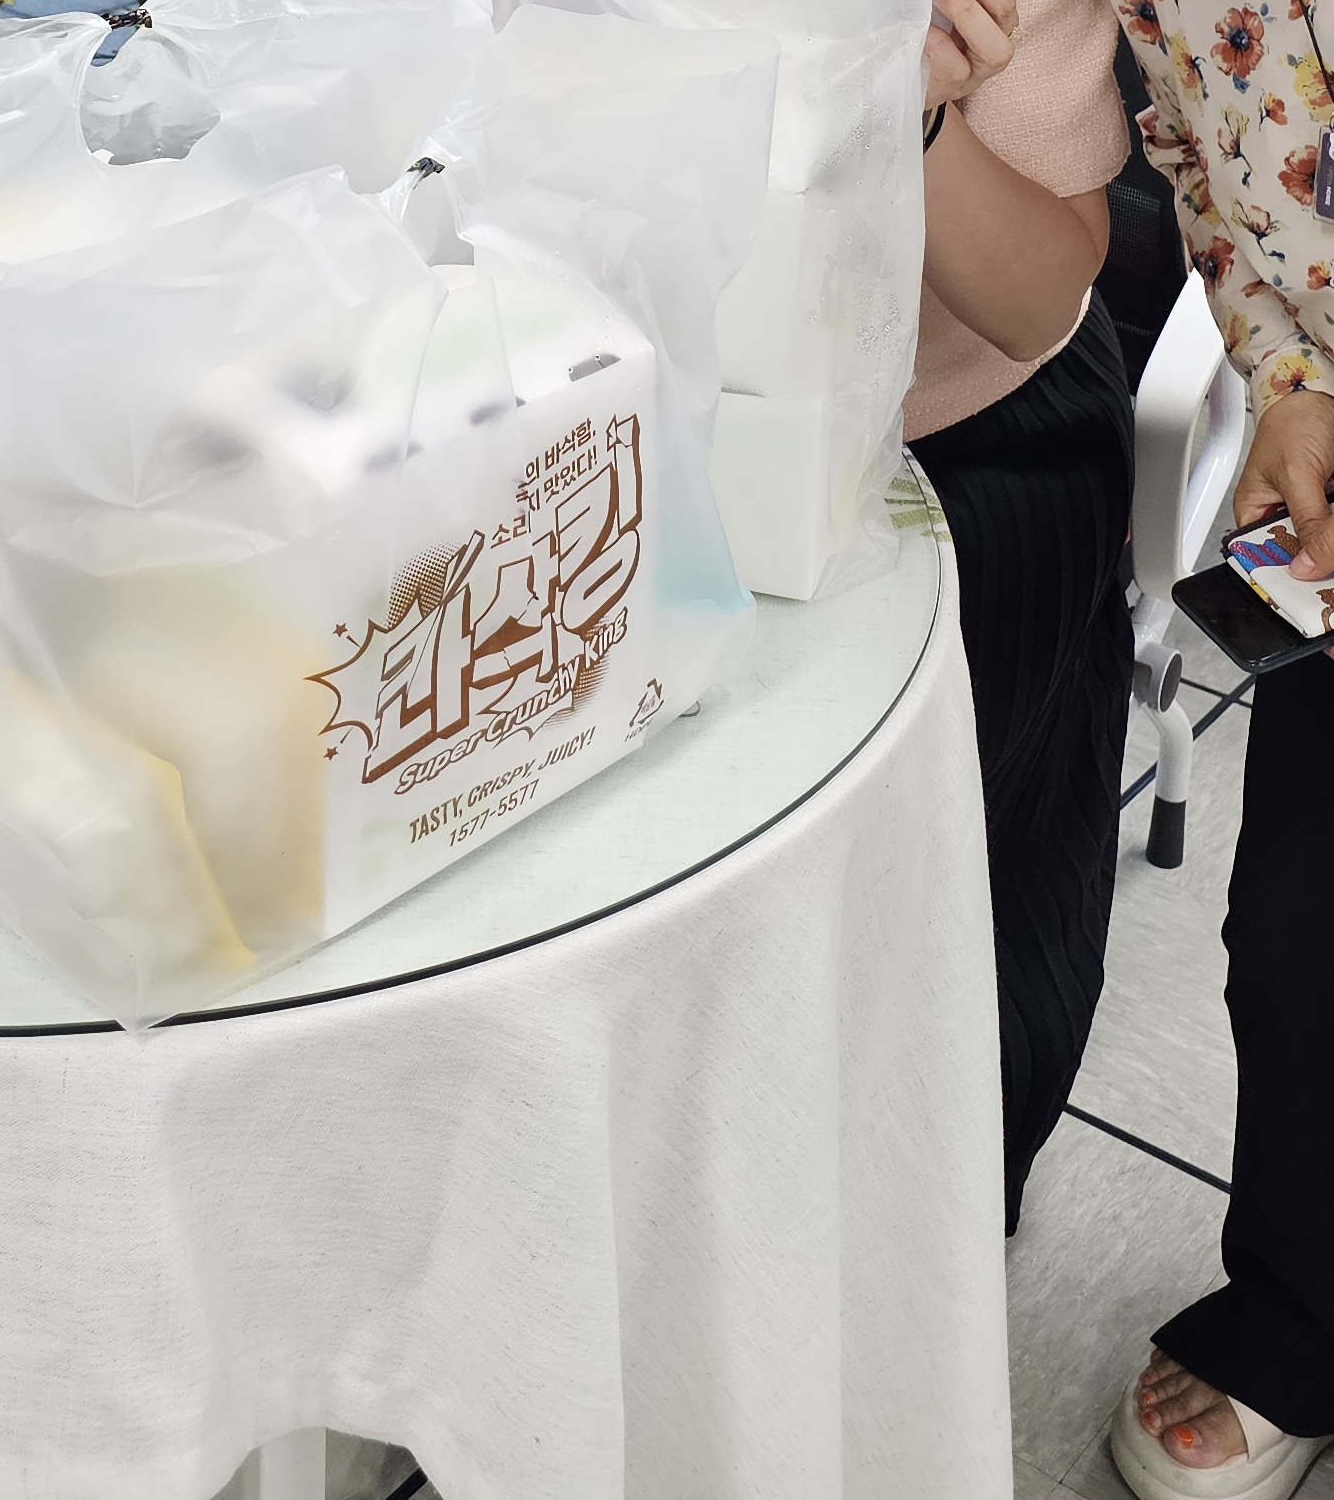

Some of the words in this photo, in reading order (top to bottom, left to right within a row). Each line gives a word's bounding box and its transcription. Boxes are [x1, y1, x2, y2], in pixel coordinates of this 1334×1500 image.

[543, 444, 598, 504] 맛있다!
[394, 727, 487, 795] Super
[483, 654, 581, 744] Crunchy
[582, 605, 628, 669] King
[409, 792, 464, 844] TASTY,
[467, 757, 536, 808] CRISPY,
[537, 725, 597, 772] JUICY!
[449, 778, 540, 848] 1577-5577
